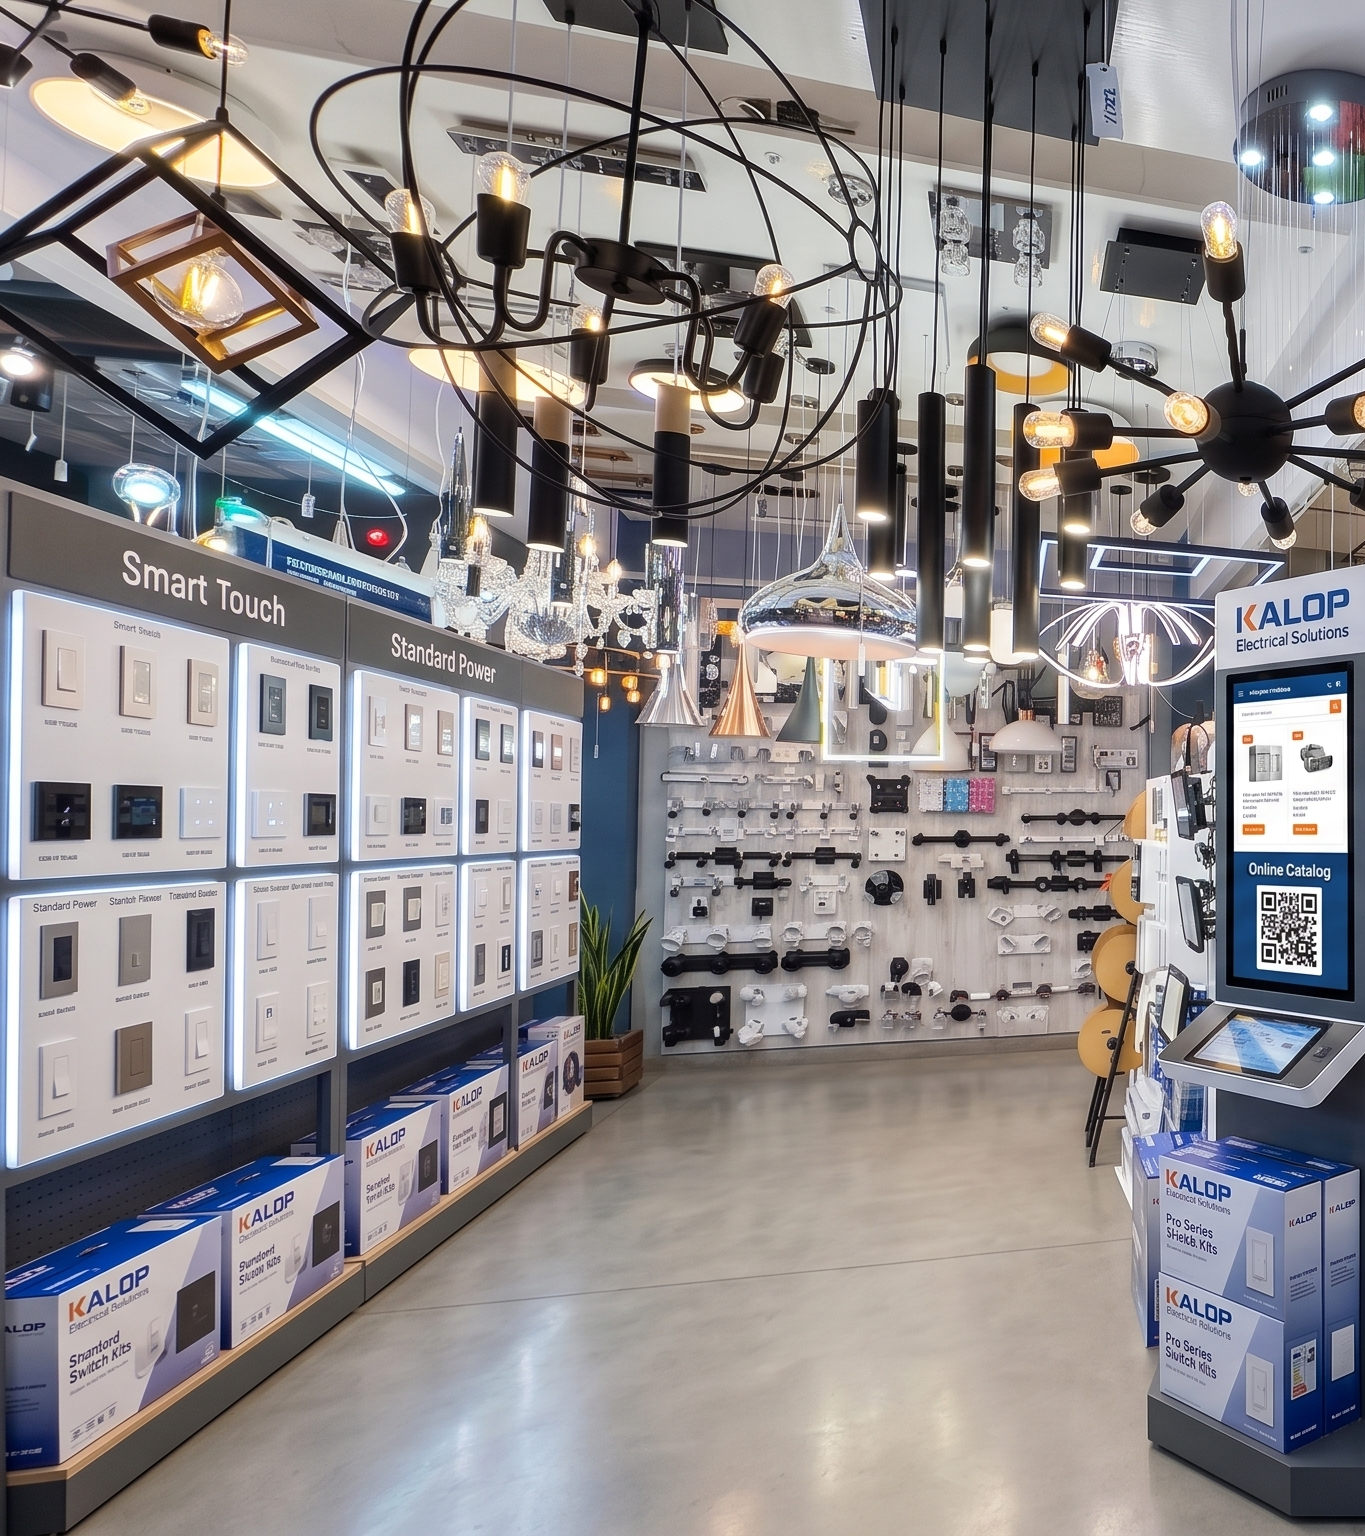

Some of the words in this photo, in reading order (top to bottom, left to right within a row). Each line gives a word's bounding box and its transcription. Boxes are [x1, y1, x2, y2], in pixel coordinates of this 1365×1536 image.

[122, 550, 208, 606] Smart
[216, 578, 286, 627] Touch
[1236, 588, 1350, 634] KALOP
[1236, 632, 1288, 652] Electrical
[1291, 626, 1349, 645] Solutions
[391, 632, 456, 673] Standard
[459, 653, 497, 684] Power
[1248, 862, 1284, 876] Online
[1286, 863, 1331, 881] Catalog
[33, 902, 71, 913] Standard
[366, 1127, 406, 1160] KALOP
[1165, 1168, 1232, 1202] KALOP
[238, 1190, 295, 1233] KALOP
[1166, 1212, 1182, 1228] Pro
[1184, 1219, 1214, 1240] Series
[68, 1264, 150, 1323] KALOP
[1166, 1286, 1232, 1326] KALOP
[5, 1321, 46, 1334] ALOP
[1165, 1331, 1181, 1349] Pro
[1183, 1339, 1212, 1363] Series
